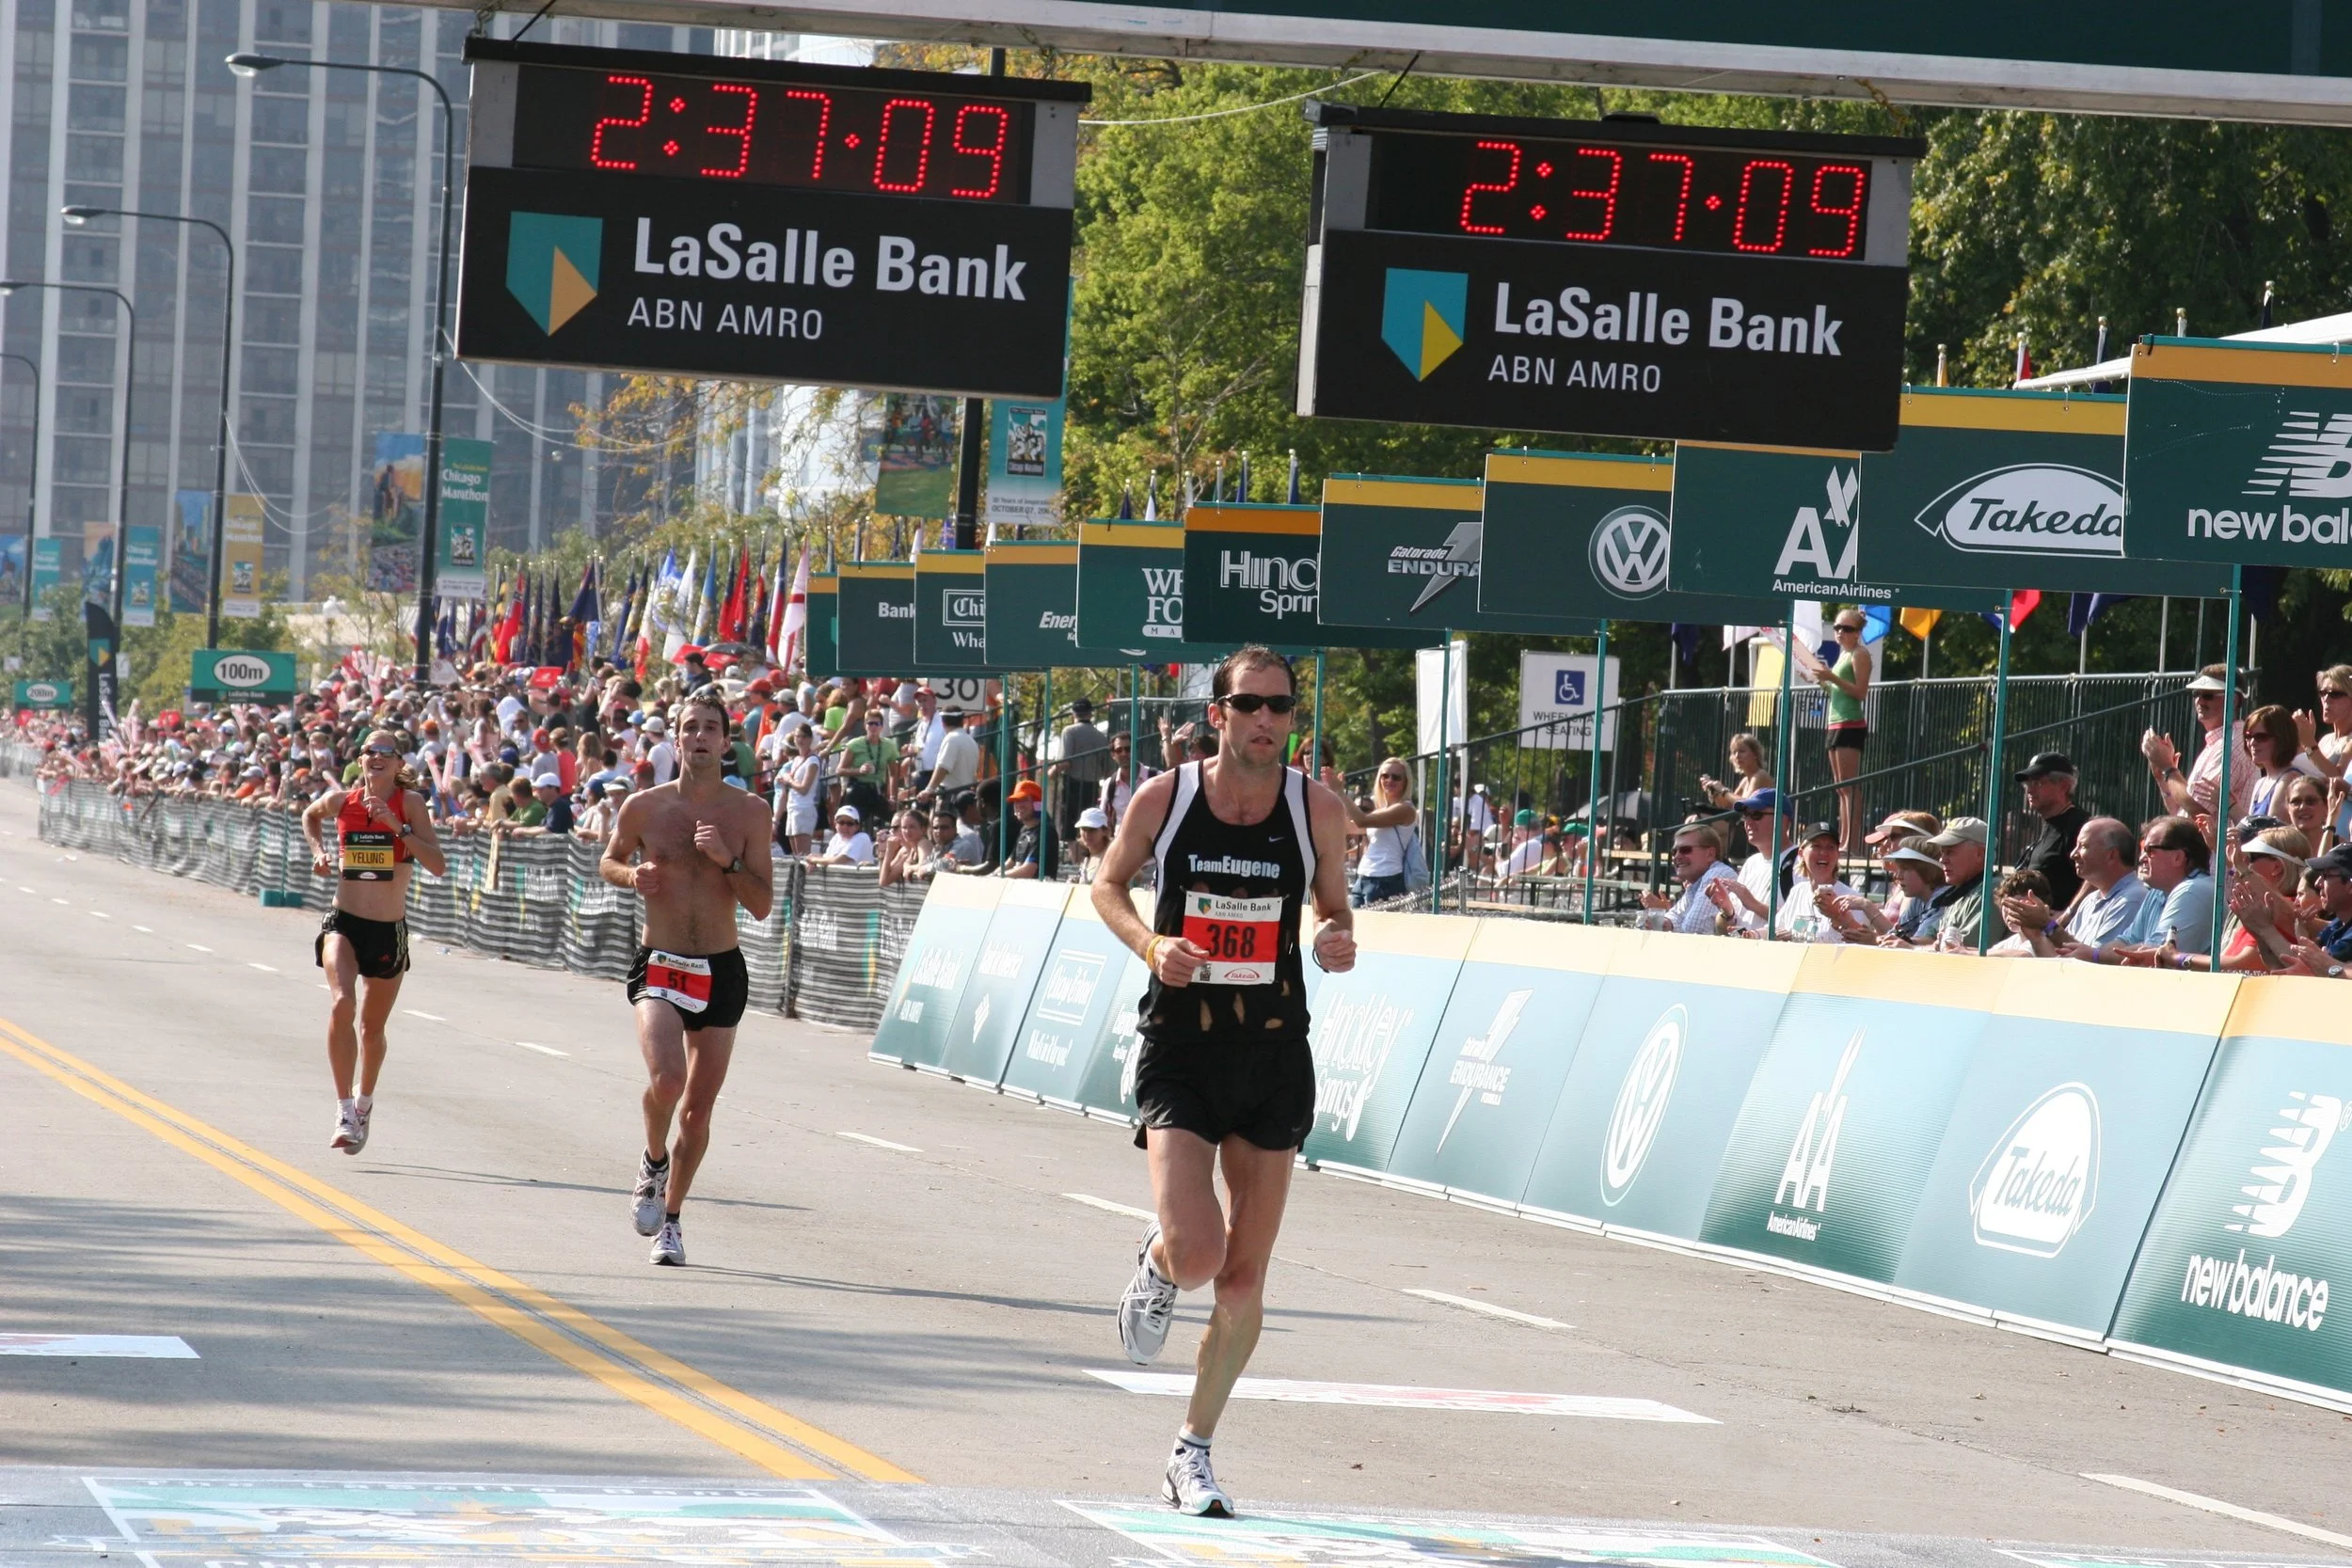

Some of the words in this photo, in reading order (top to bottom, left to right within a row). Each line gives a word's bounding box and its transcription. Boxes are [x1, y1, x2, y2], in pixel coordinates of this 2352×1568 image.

[634, 217, 853, 288] LaSalle
[876, 235, 1027, 301] Bank
[628, 297, 703, 331] ABN
[717, 305, 822, 340] AMRO
[1495, 282, 1690, 344] LaSalle
[1708, 297, 1842, 356] Bank
[1488, 354, 1554, 384] ABN
[1567, 360, 1661, 393] AMRO
[442, 469, 482, 485] Chicago
[441, 486, 489, 502] Marathon
[2187, 509, 2277, 541] new
[2282, 505, 2352, 544] bal
[1391, 546, 1449, 560] Gatorade
[1220, 550, 1317, 591] Hinc
[1772, 579, 1892, 599] AmericanAirlines
[1039, 611, 1076, 631] Ener
[220, 663, 262, 679] 100m
[936, 678, 978, 702] 30
[1546, 725, 1592, 736] SEATING
[352, 852, 385, 863] YELLING
[1188, 854, 1280, 879] TeamEugene
[1216, 900, 1248, 911] LaSalle
[1250, 903, 1271, 911] Bank
[1206, 923, 1256, 958] 368
[668, 972, 688, 991] 51
[1313, 991, 1409, 1101] Hinckley
[1449, 1060, 1512, 1093] ENDURANCE
[1993, 1147, 2081, 1216] Takeda
[2181, 1254, 2234, 1309] new
[2228, 1248, 2329, 1331] balance
